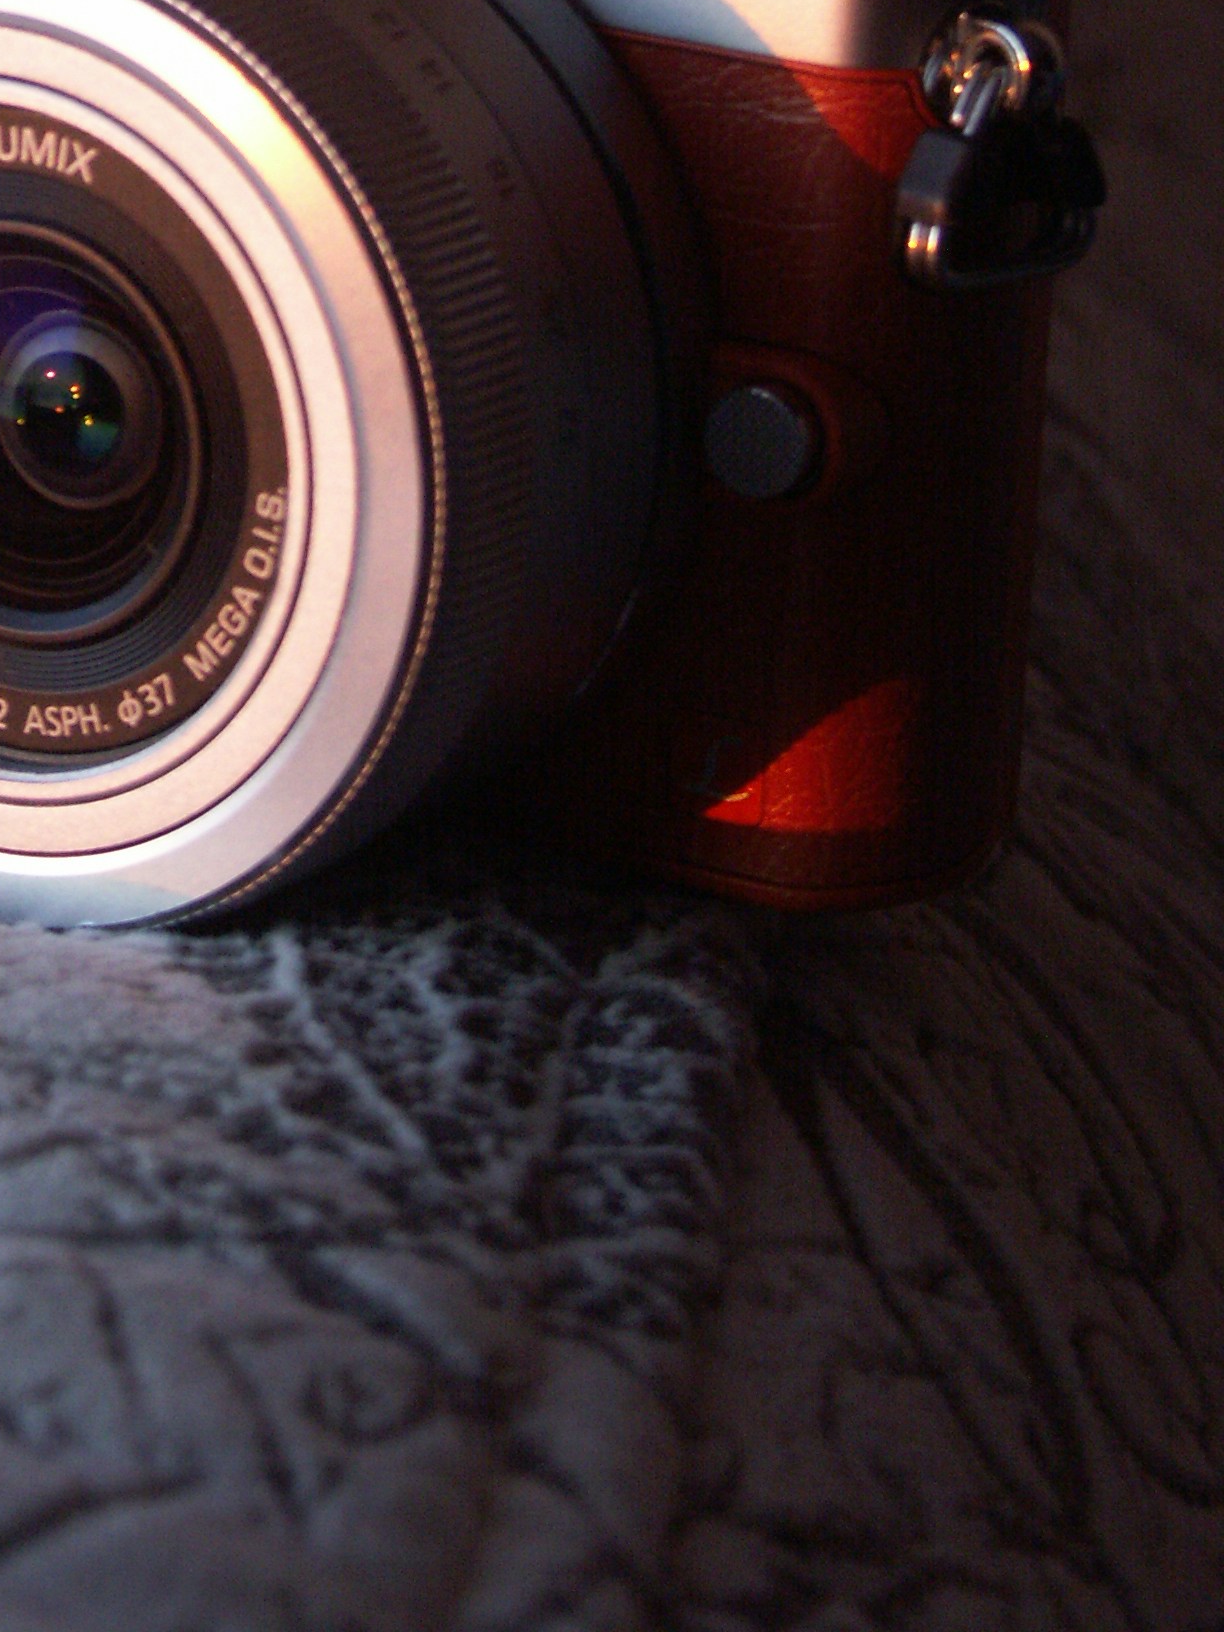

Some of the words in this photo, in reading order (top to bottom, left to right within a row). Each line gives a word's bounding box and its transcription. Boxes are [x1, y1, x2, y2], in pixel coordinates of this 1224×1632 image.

[22, 702, 112, 738] ASPH.
[182, 584, 263, 682] MEGA
[242, 486, 289, 580] O.I.S.
